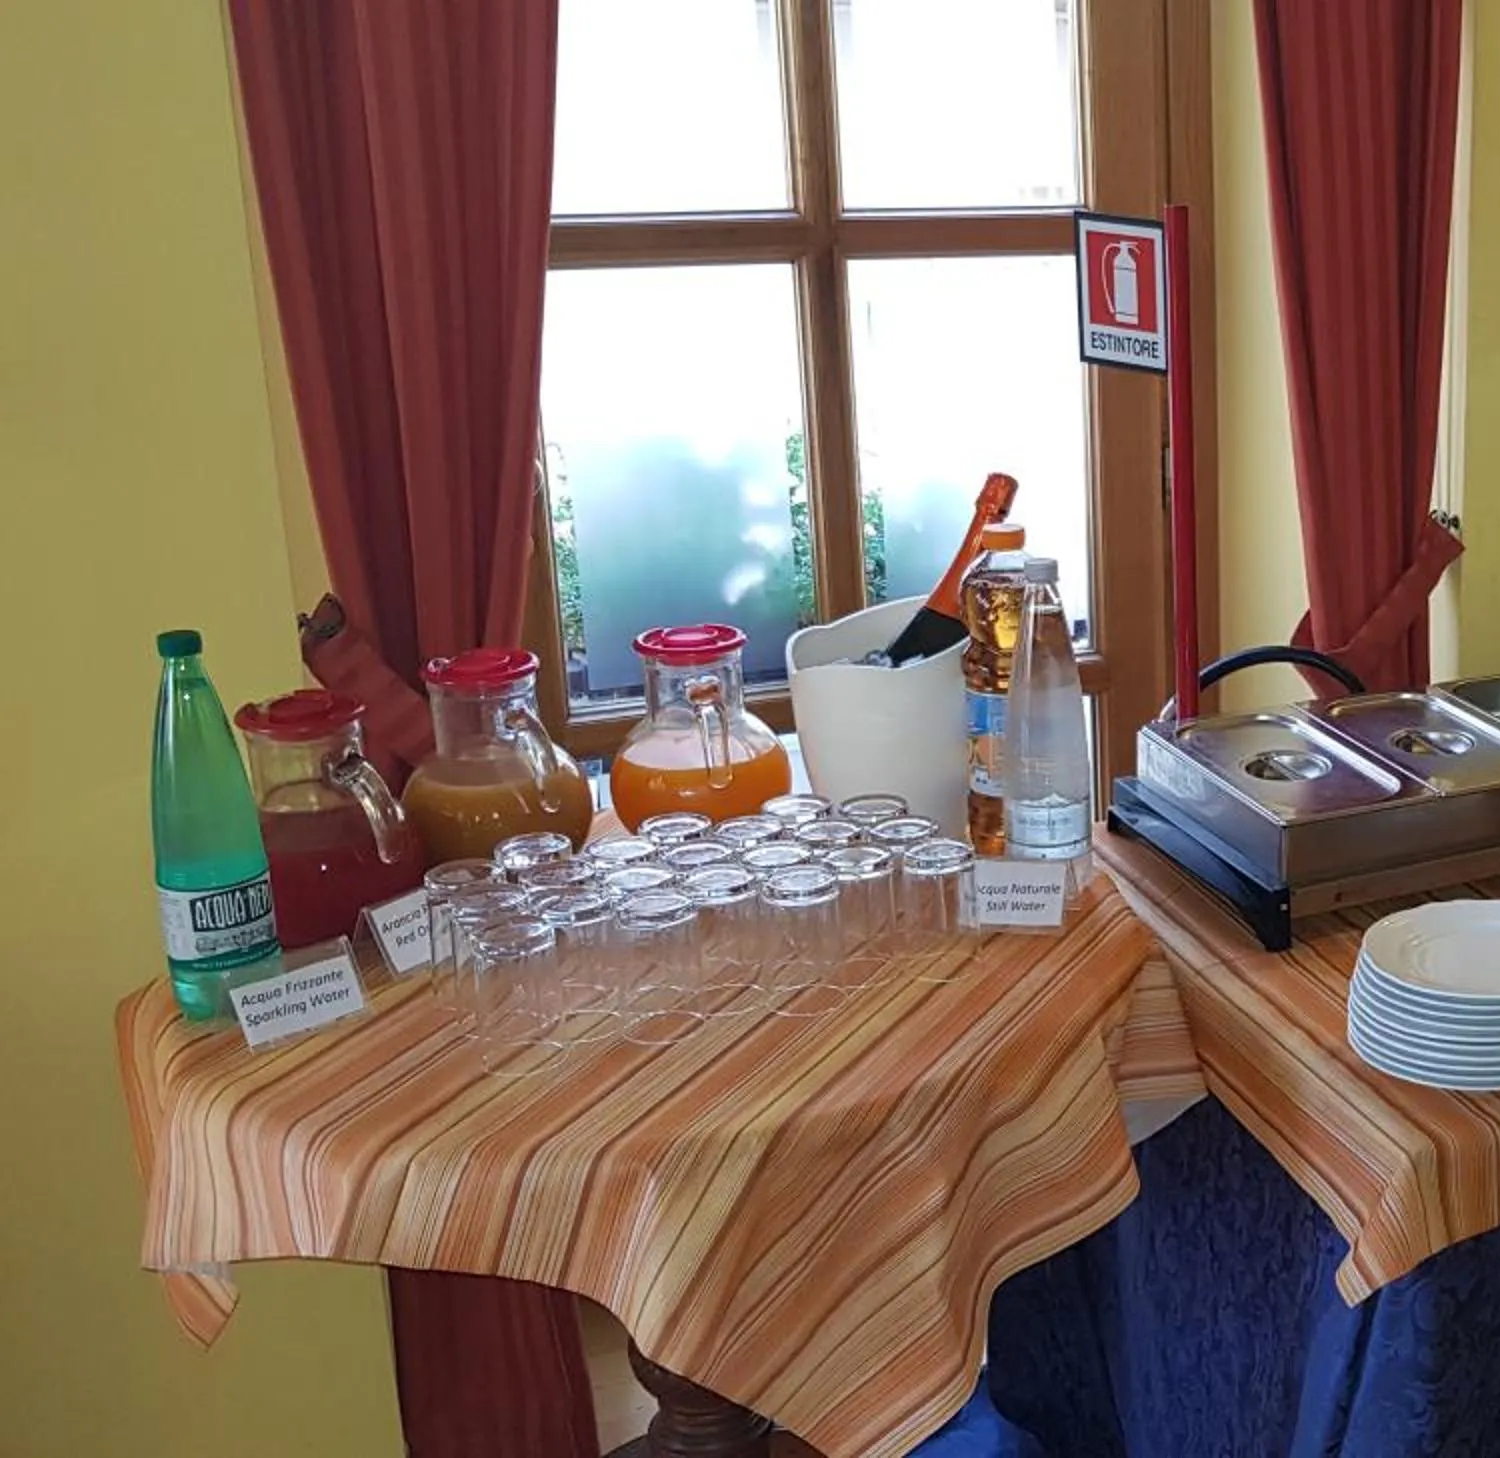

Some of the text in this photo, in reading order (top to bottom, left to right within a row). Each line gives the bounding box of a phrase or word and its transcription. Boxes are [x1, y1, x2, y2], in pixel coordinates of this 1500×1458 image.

[1090, 331, 1161, 359] ESTINTORE
[976, 883, 1062, 897] cqua Naturale
[985, 900, 1046, 913] Still Water
[194, 889, 246, 929] ACQUA
[241, 970, 344, 1008] Acqua Frizzante
[245, 988, 350, 1027] Sparkling Water
